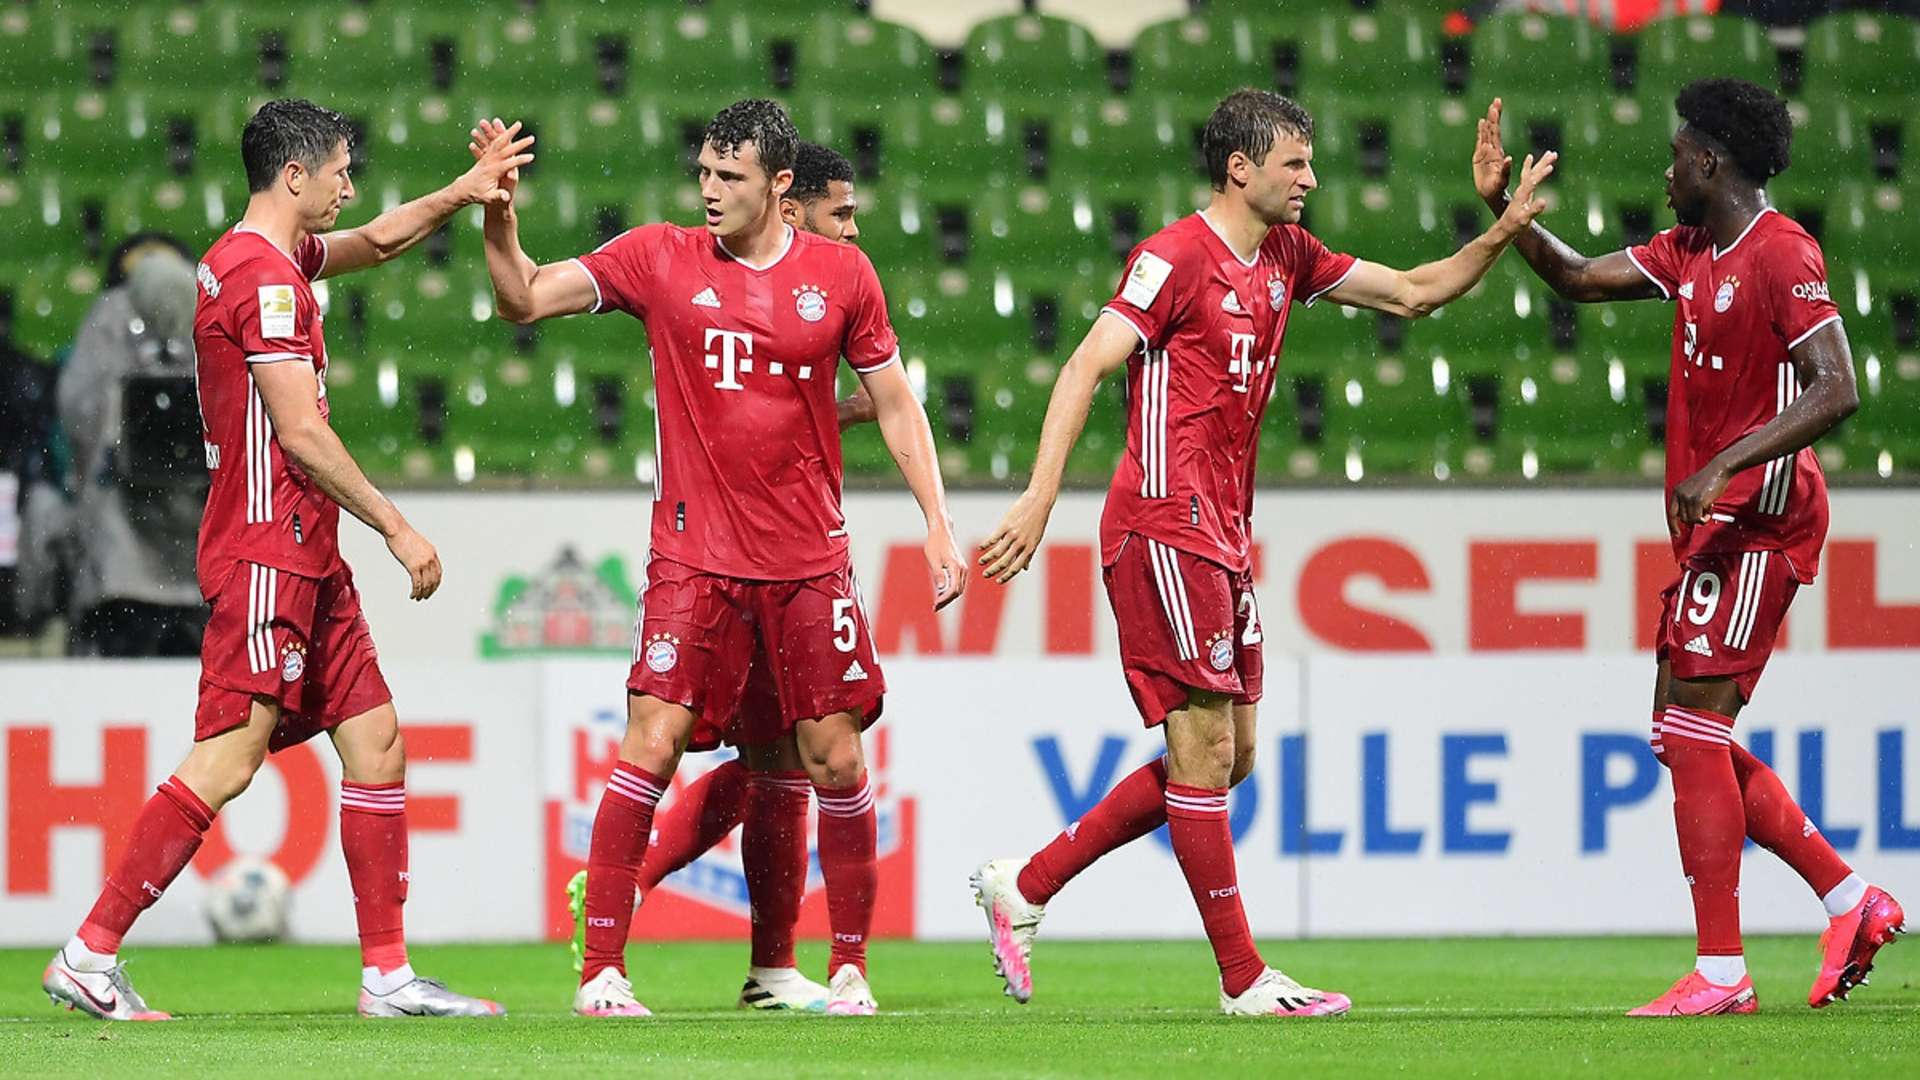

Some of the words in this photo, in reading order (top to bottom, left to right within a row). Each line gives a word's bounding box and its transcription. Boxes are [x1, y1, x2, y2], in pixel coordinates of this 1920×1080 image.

[832, 598, 857, 653] 5
[1674, 570, 1721, 626] 19
[1579, 727, 1920, 856] PLL
